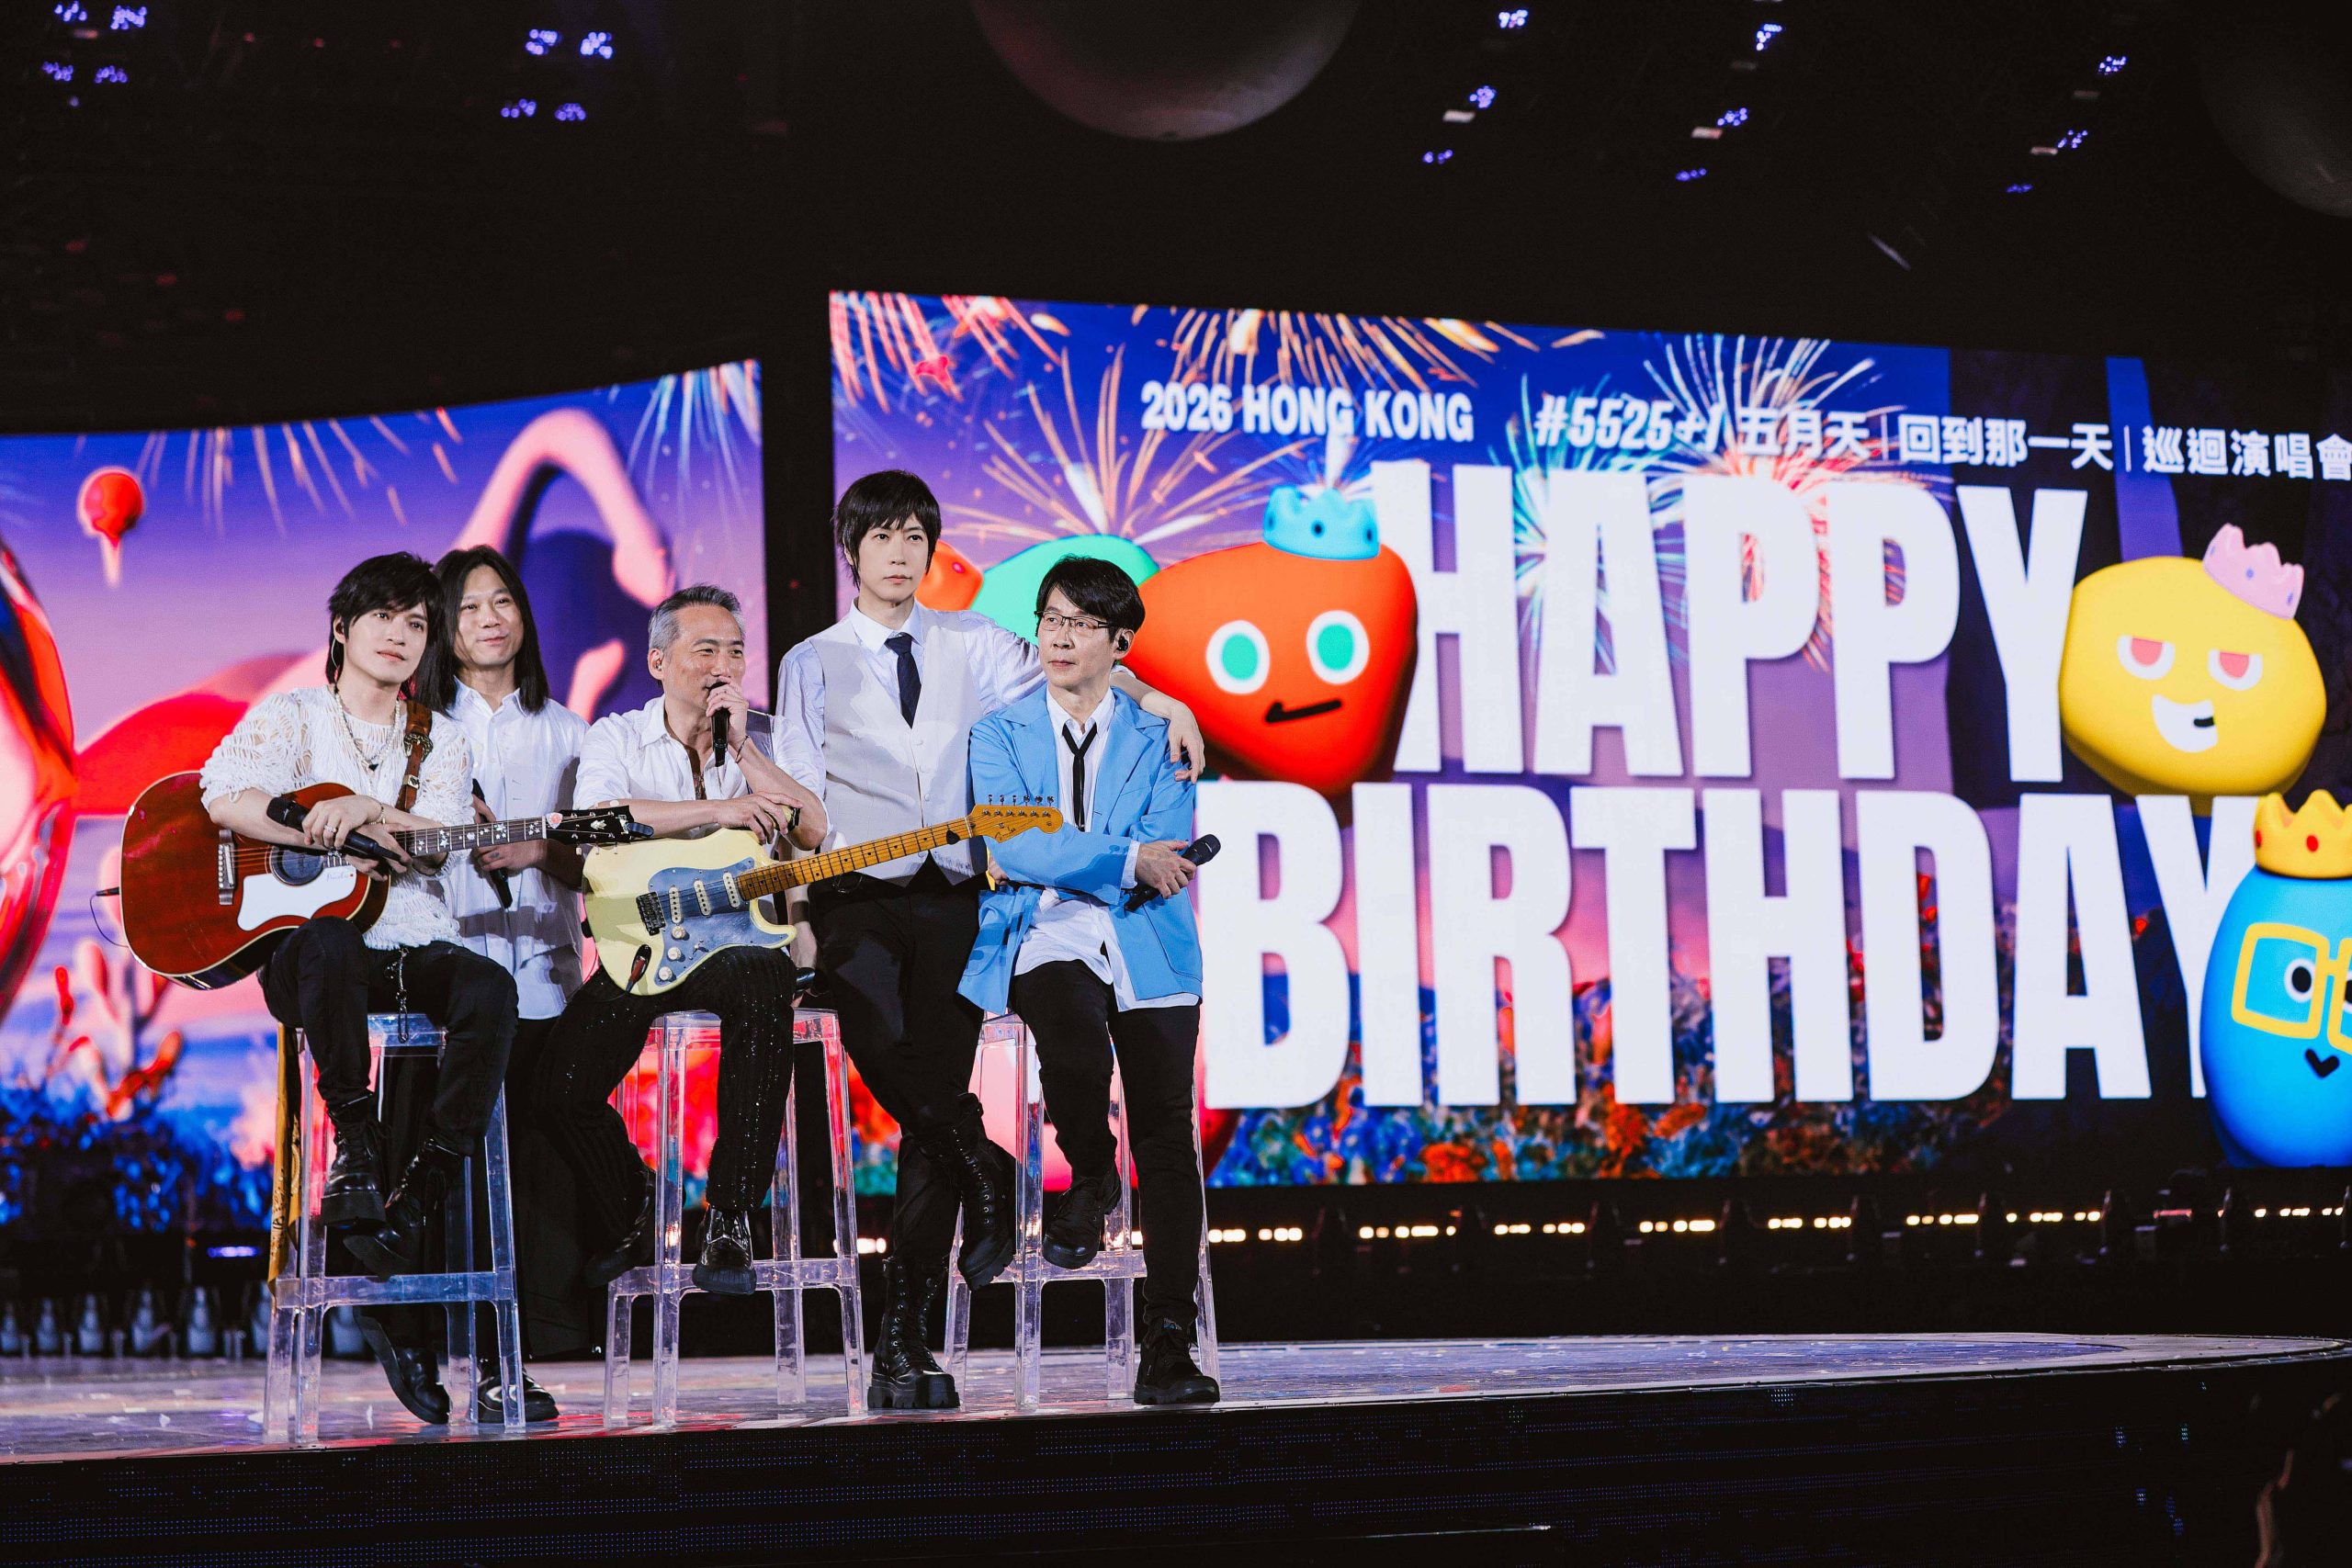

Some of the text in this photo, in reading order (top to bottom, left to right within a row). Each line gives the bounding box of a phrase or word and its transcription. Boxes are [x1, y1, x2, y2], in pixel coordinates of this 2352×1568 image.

[1141, 380, 1474, 442] 2026 HONG KONG
[1738, 407, 1871, 459] 五月天
[1370, 459, 2087, 783] HAPPY
[1196, 780, 2259, 1110] BIRTHDAY
